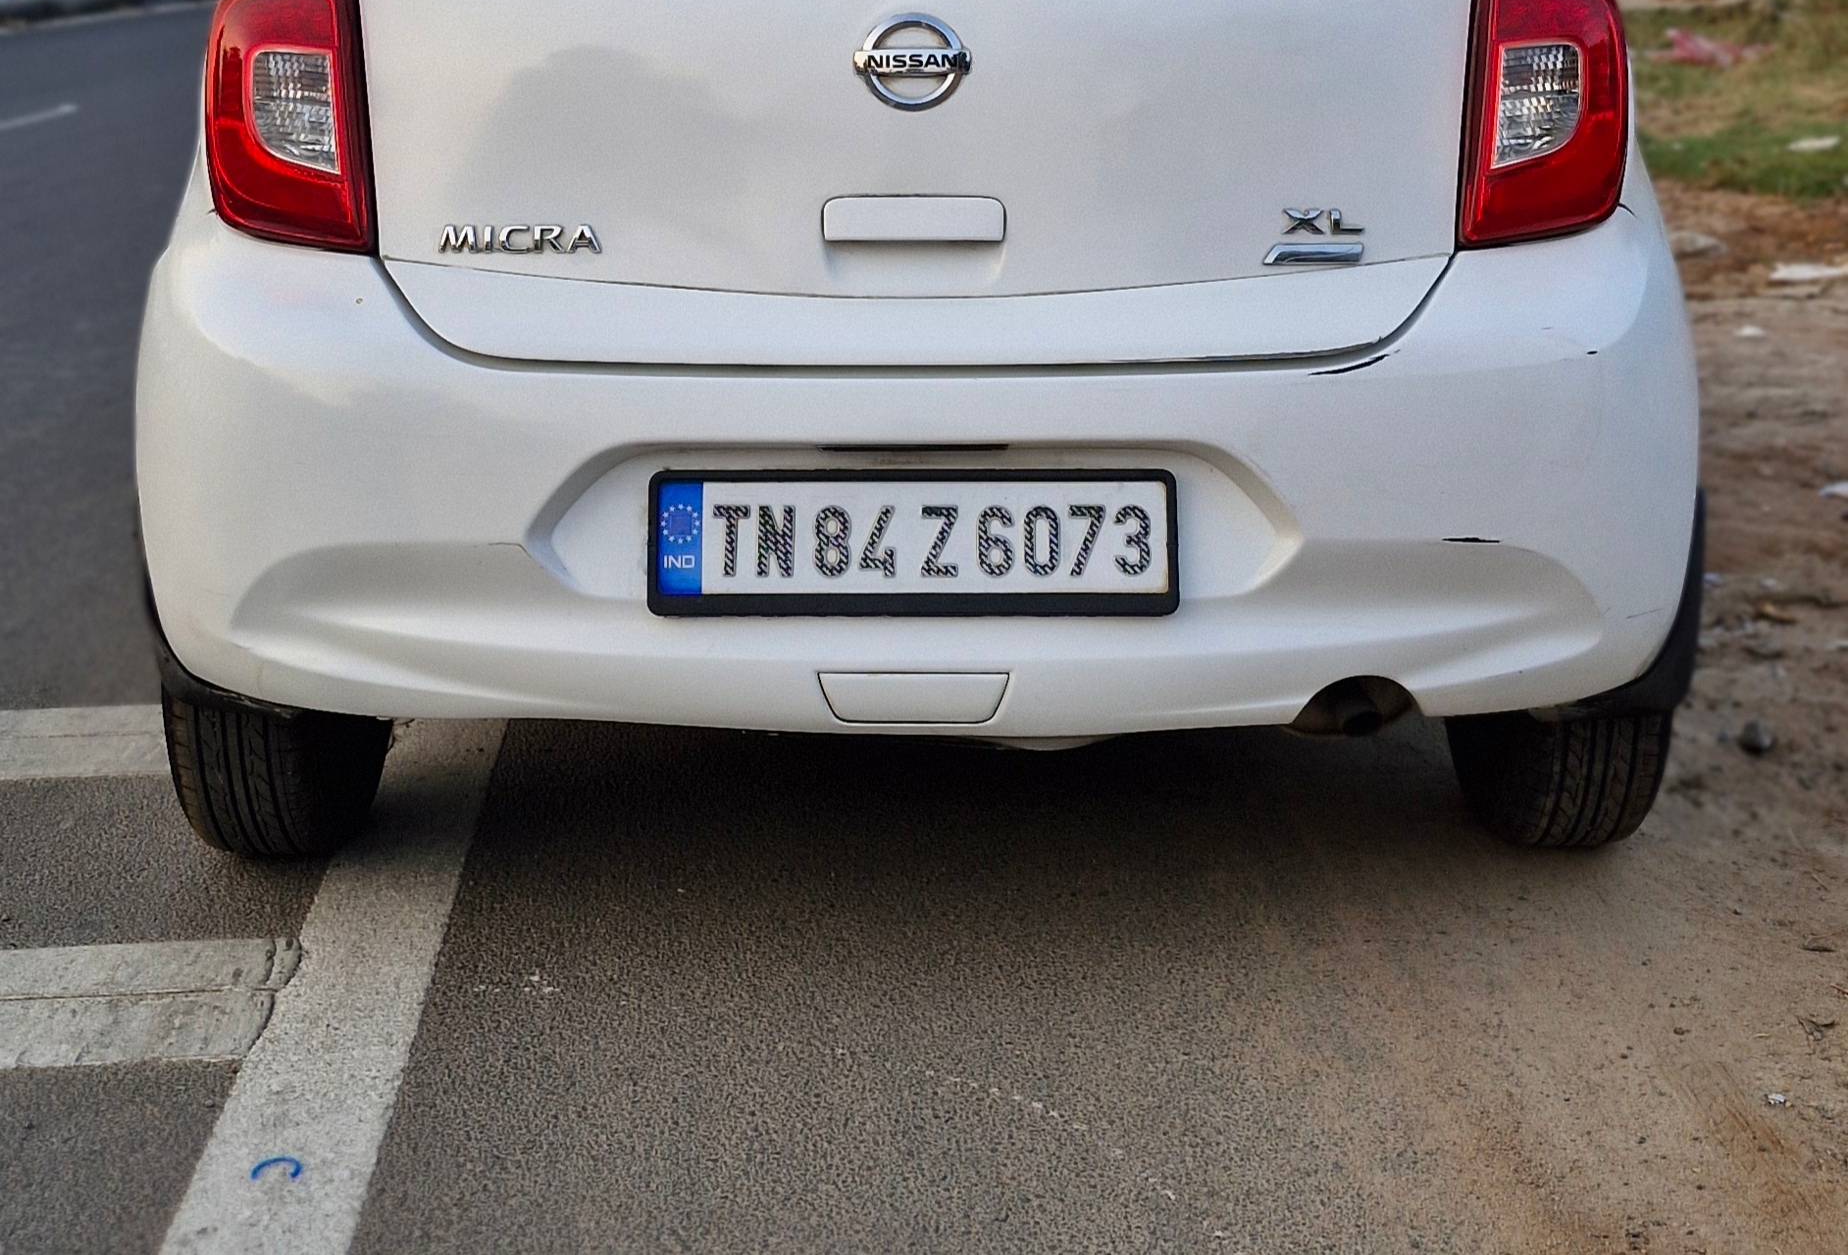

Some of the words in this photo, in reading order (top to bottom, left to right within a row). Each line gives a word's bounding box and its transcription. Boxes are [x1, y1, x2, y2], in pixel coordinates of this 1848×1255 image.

[867, 54, 958, 69] NISSAN
[1282, 208, 1365, 235] XL
[438, 224, 601, 254] MICRA
[712, 504, 797, 578] TN
[813, 504, 896, 579] 84
[920, 505, 960, 578] Z
[976, 504, 1153, 578] 6073
[663, 555, 696, 569] IND
